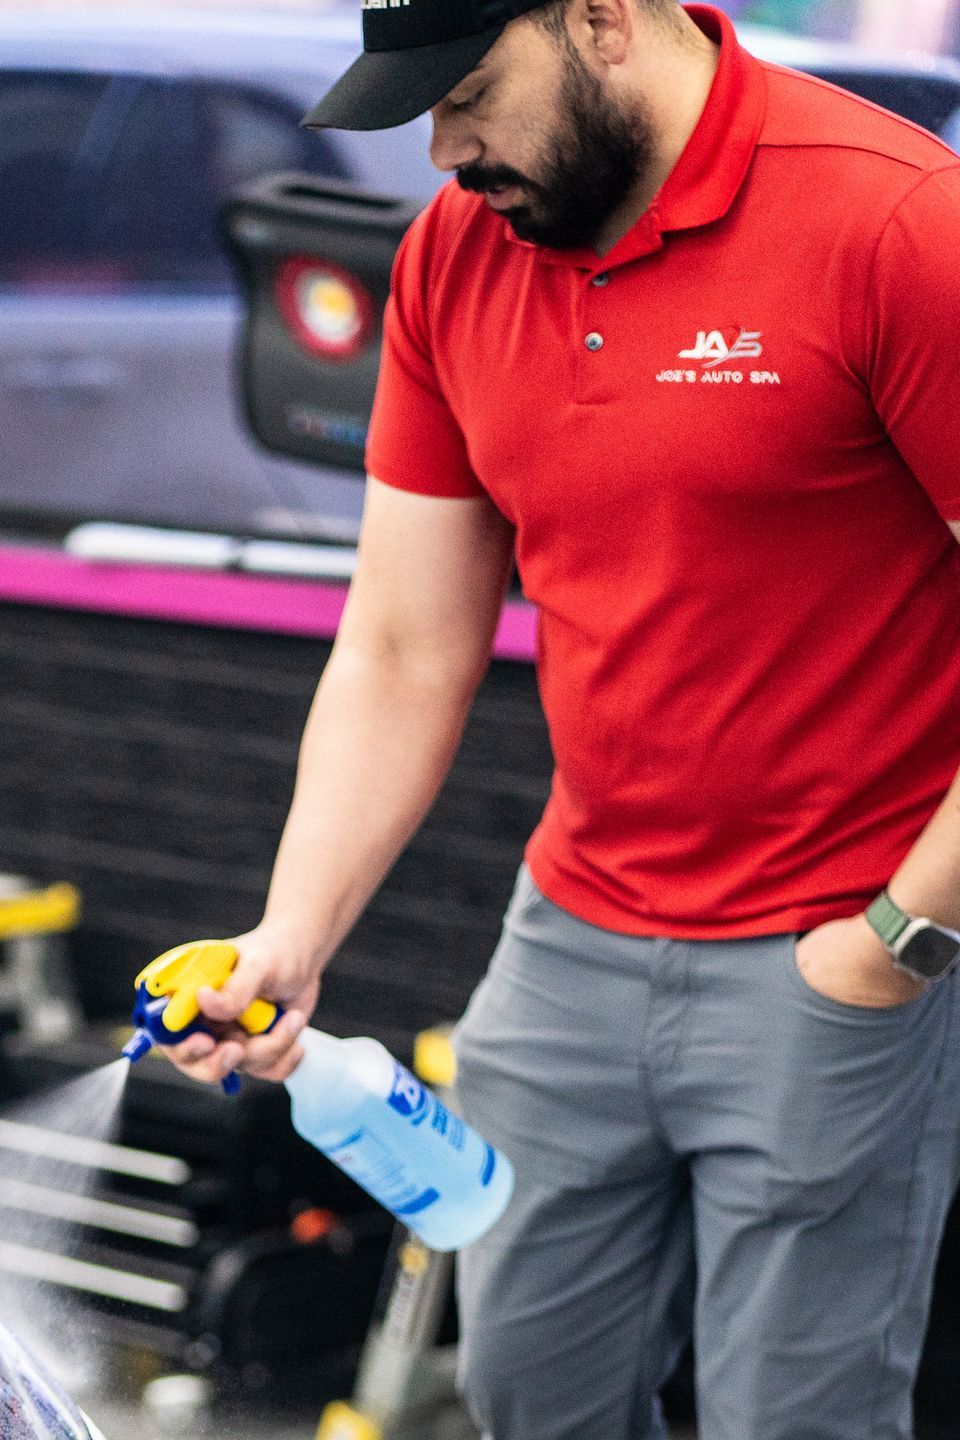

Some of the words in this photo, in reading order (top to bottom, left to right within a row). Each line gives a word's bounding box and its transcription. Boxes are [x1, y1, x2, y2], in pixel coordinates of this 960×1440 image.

[655, 369, 697, 383] JOE'S
[700, 370, 743, 384] AUTO
[749, 370, 781, 384] SPA
